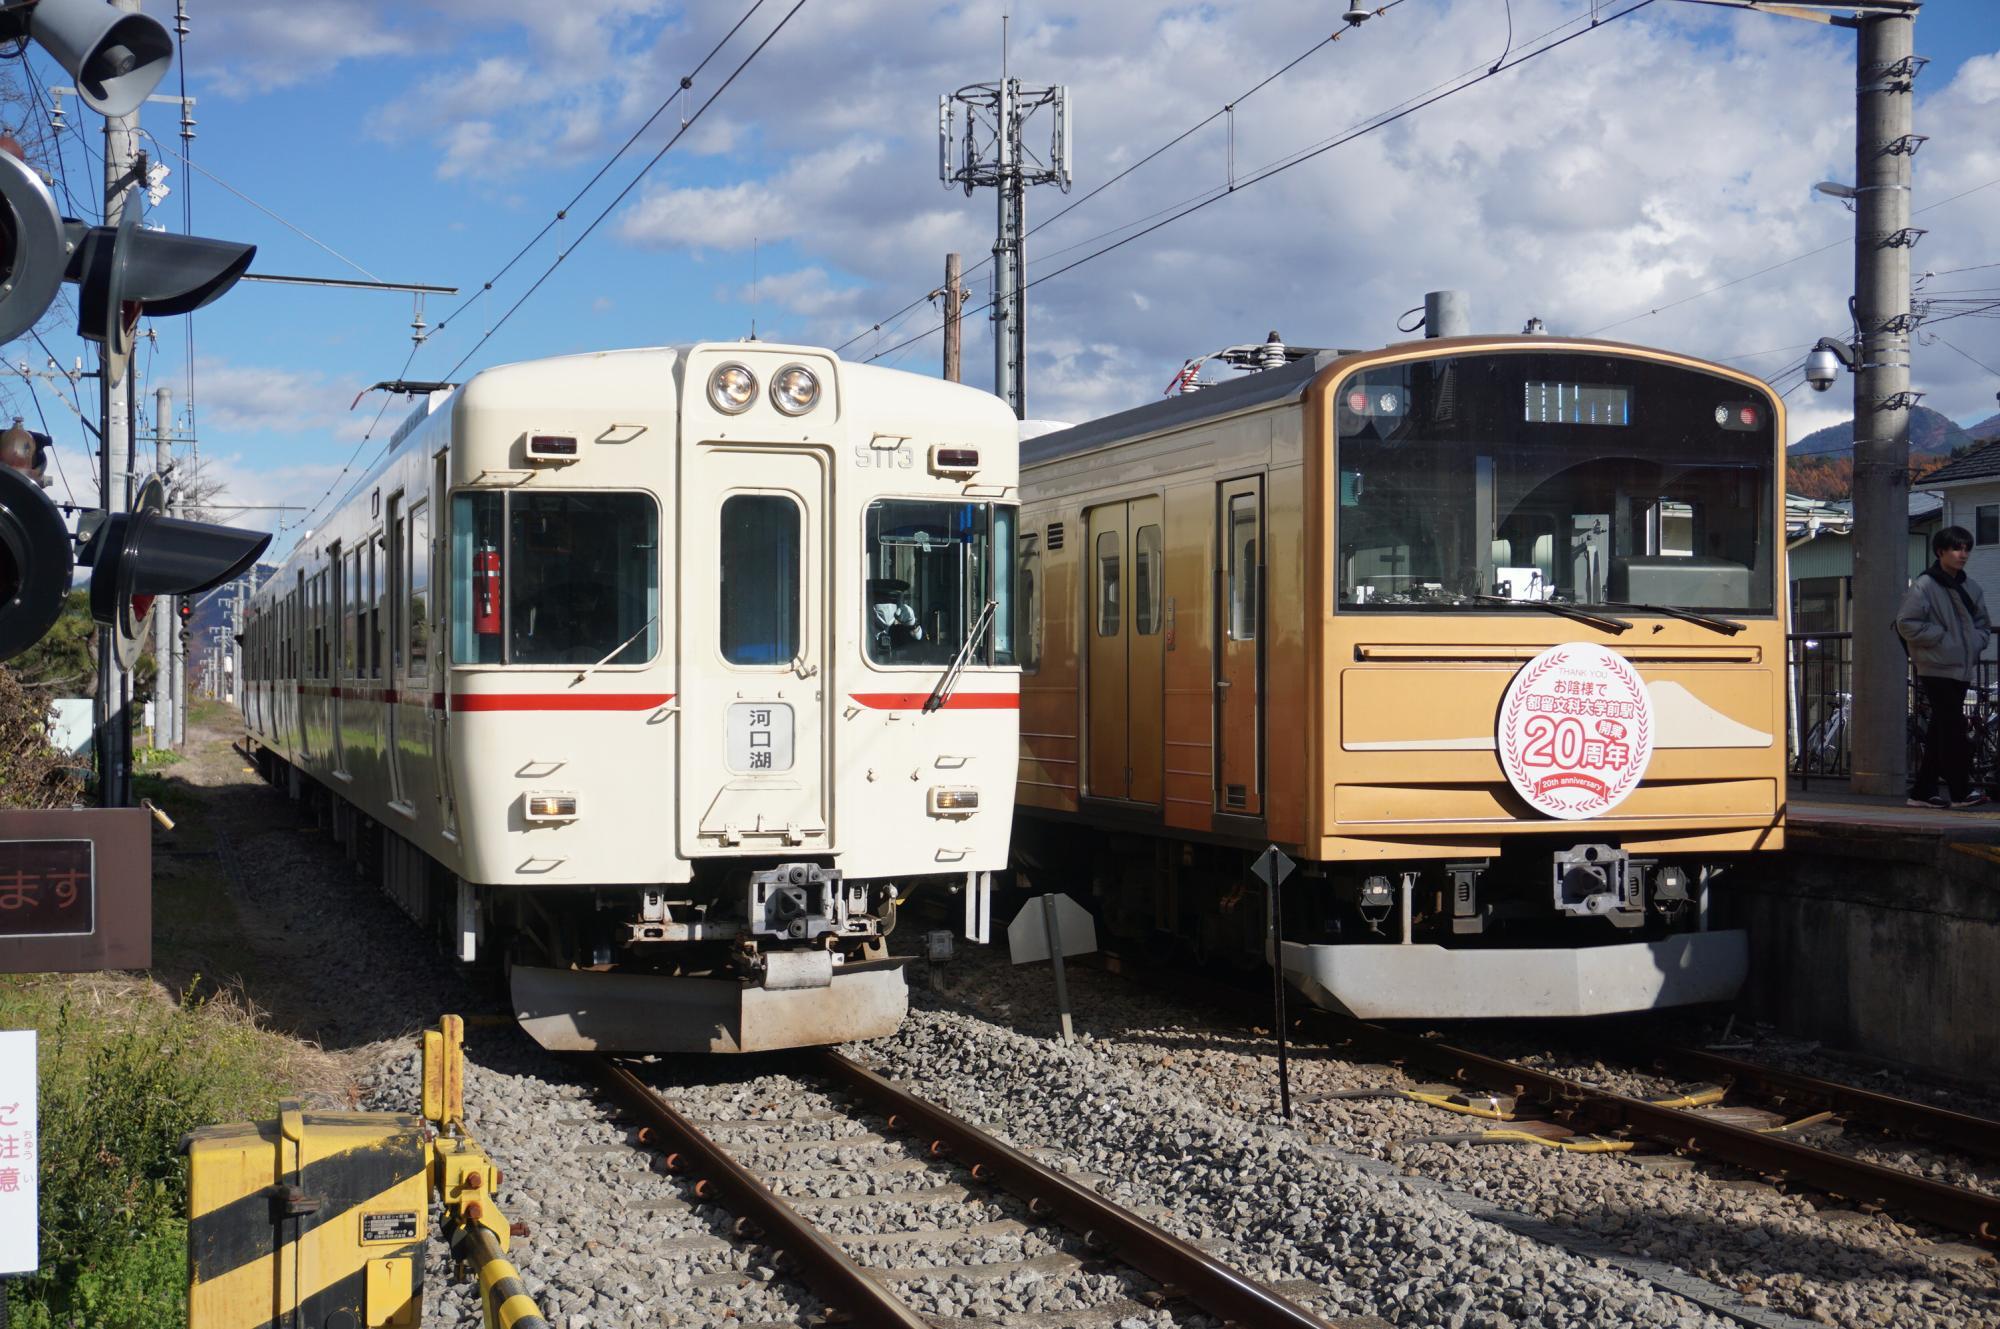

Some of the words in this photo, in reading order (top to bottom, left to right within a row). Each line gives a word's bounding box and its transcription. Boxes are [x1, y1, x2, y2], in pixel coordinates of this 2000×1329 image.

[855, 446, 914, 468] 5113
[1558, 667, 1587, 677] THANK
[1590, 669, 1608, 679] YOU
[1554, 680, 1608, 697] お陰様で
[1526, 694, 1634, 720] 都留文科大学前駅
[749, 709, 772, 769] 河口湖
[1598, 721, 1625, 739] 開業
[1522, 715, 1630, 771] 20周年
[1542, 777, 1559, 789] 20th
[1560, 777, 1602, 791] anniversary
[0, 870, 89, 910] ます
